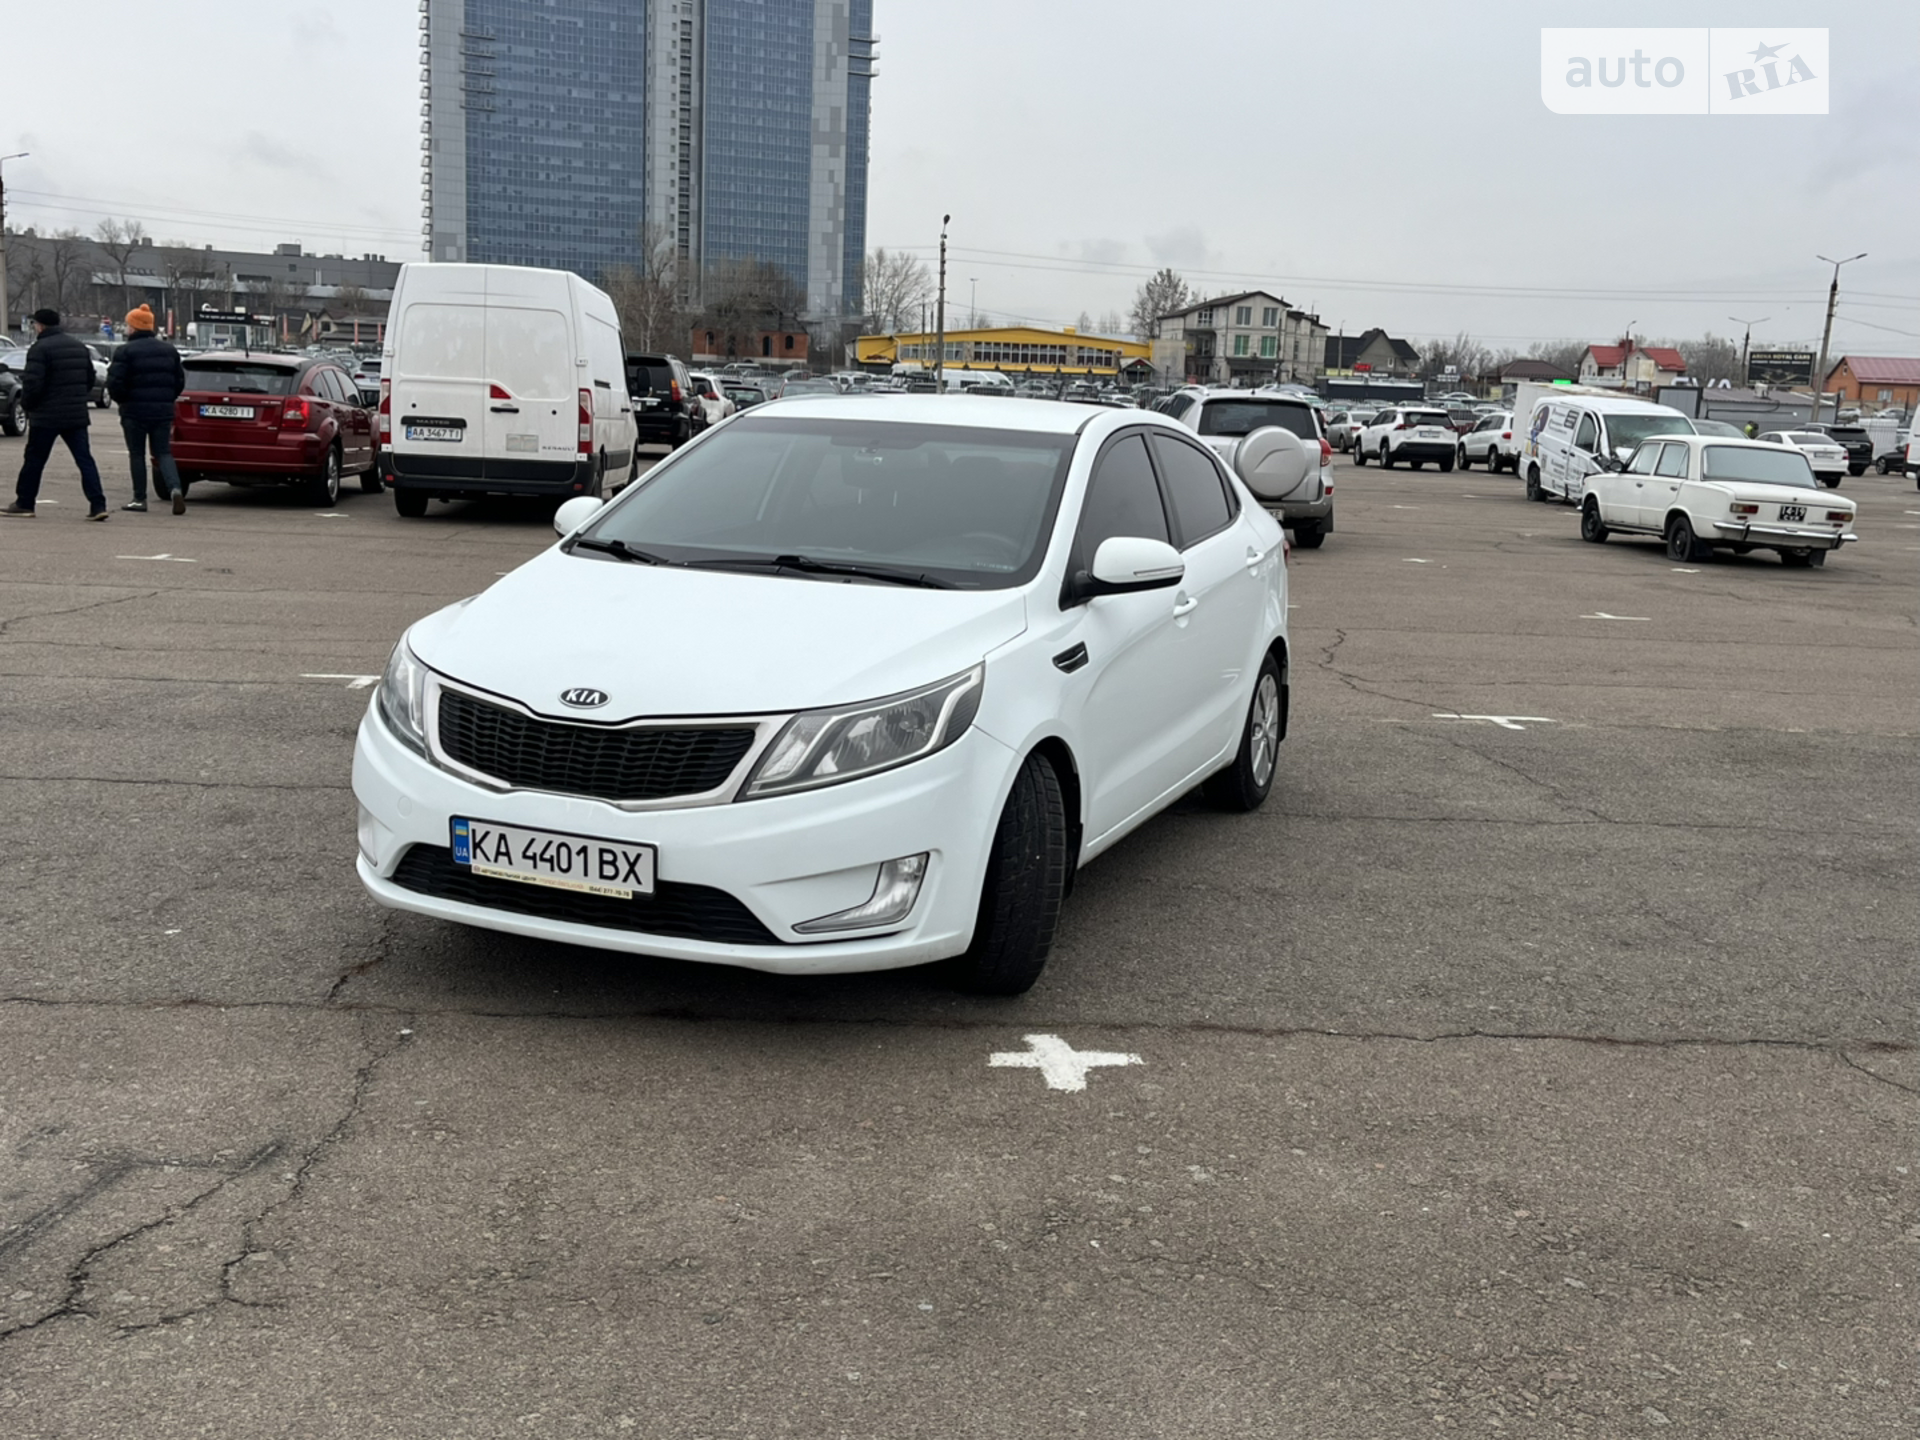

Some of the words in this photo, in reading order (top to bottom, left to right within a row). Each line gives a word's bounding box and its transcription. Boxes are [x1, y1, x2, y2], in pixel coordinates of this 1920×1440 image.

[412, 428, 425, 437] AA
[427, 429, 447, 437] 3467
[565, 689, 601, 704] KIA
[455, 846, 469, 858] UA
[471, 828, 514, 866] KA
[521, 837, 588, 878] 4401
[598, 847, 643, 886] BX
